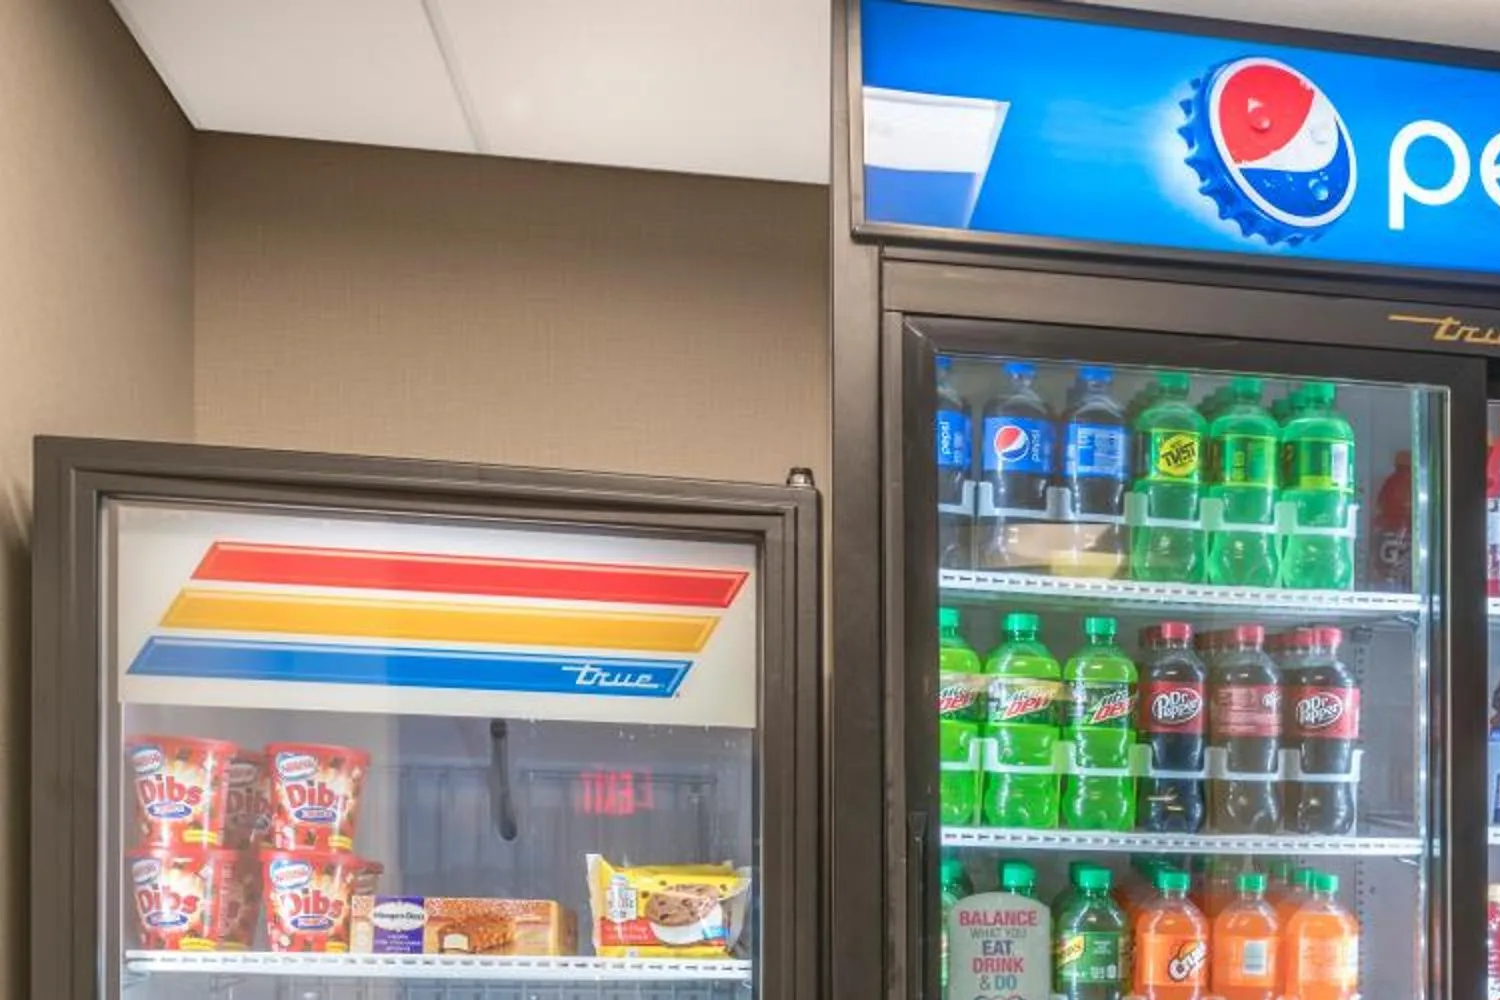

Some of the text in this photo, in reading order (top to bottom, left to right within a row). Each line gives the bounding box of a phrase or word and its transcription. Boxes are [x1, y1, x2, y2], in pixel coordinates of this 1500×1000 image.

[285, 780, 347, 811] Dib
[959, 910, 1039, 927] BALANCE
[972, 957, 1024, 973] DRINK
[979, 974, 1018, 991] & DO
